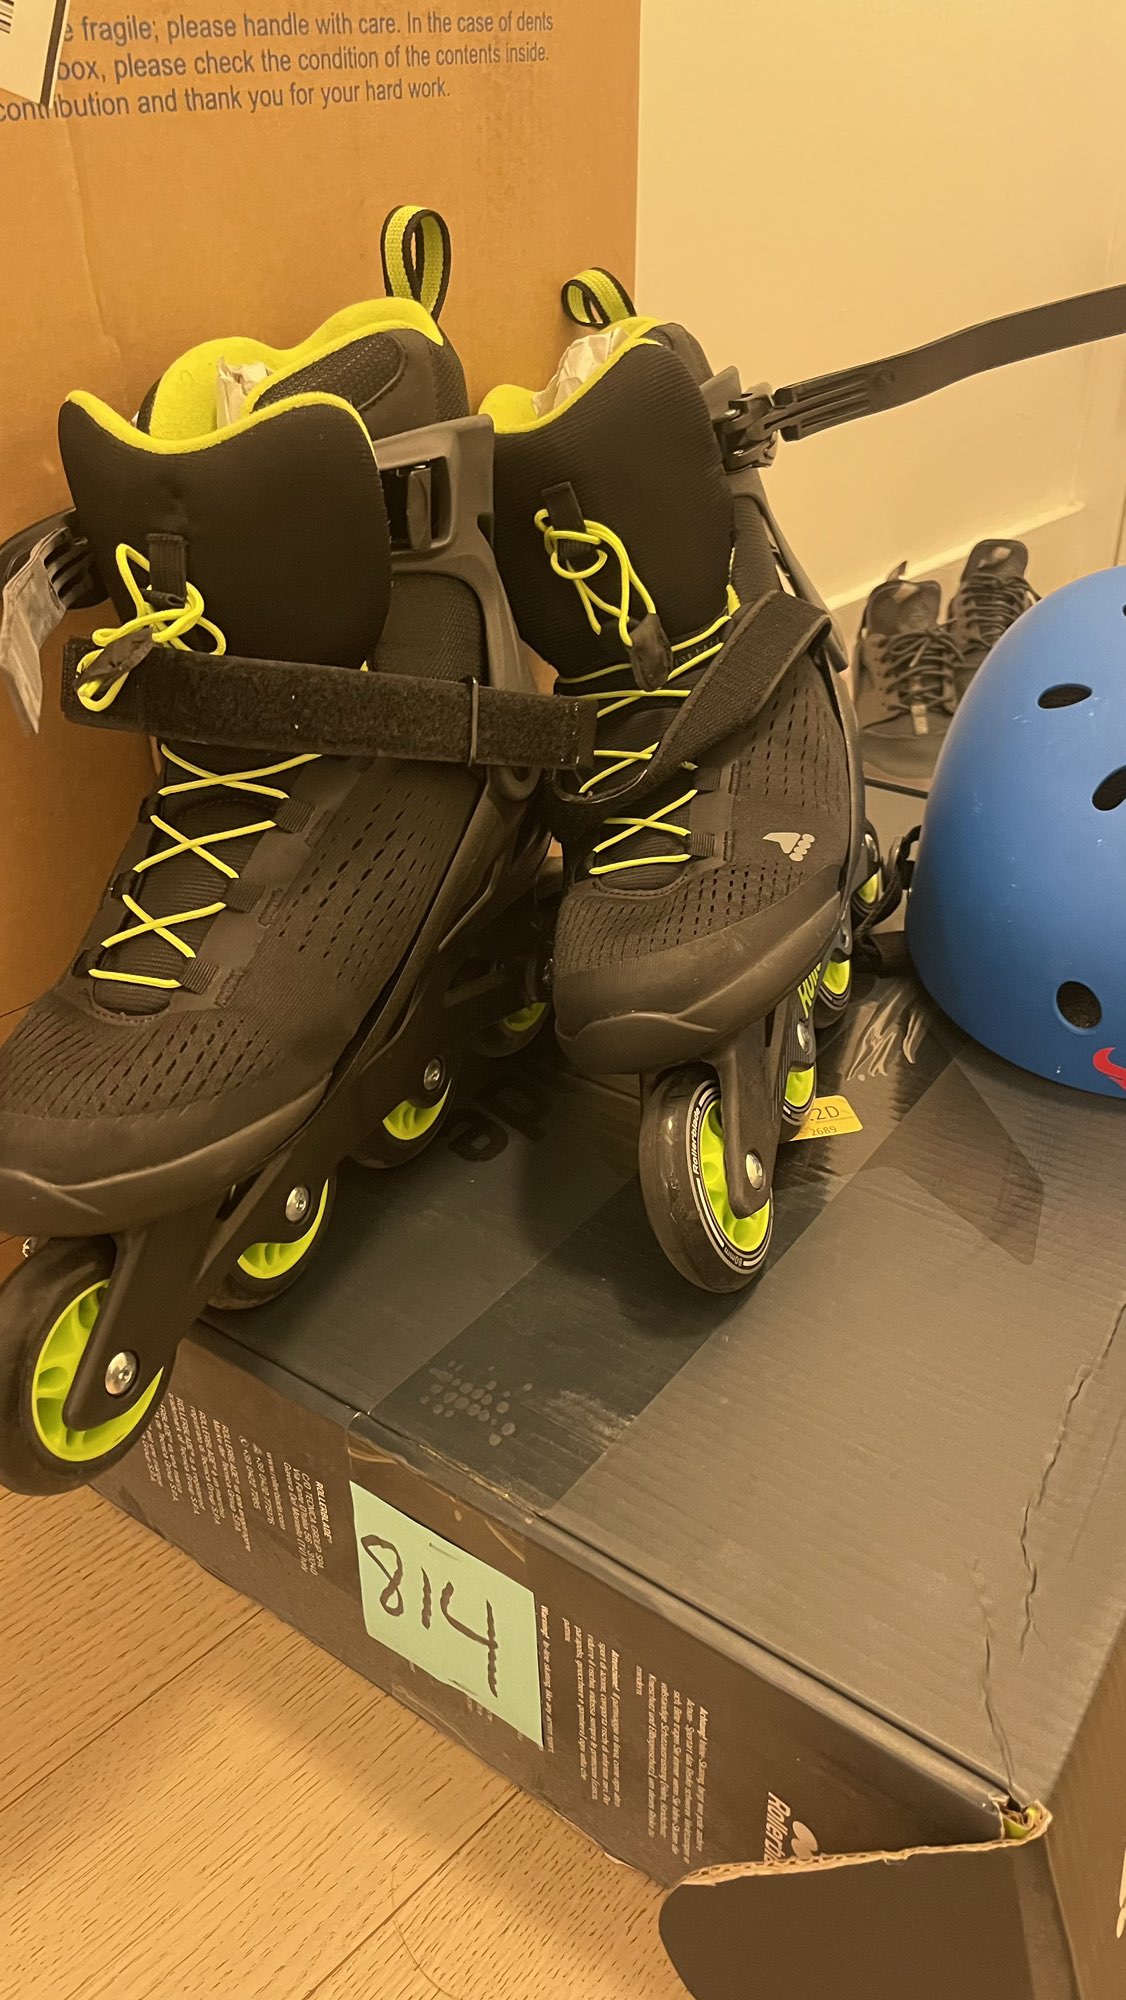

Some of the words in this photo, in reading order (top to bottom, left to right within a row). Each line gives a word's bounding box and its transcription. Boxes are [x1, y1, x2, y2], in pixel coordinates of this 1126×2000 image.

[82, 15, 158, 47] fragile;
[168, 14, 236, 45] please
[244, 12, 309, 37] handle
[316, 12, 352, 34] with
[359, 17, 400, 34] care.
[408, 12, 422, 33] In
[428, 11, 452, 32] the
[458, 15, 494, 32] case
[499, 10, 512, 32] of
[517, 11, 553, 32] dents
[115, 53, 186, 84] please
[194, 50, 254, 74] check
[262, 49, 291, 72] the
[298, 46, 378, 70] condition
[385, 45, 400, 68] of
[406, 45, 430, 66] the
[436, 44, 500, 65] contents
[506, 42, 549, 62] inside.
[138, 88, 177, 114] and
[185, 85, 242, 112] thank
[248, 88, 283, 113] you
[290, 82, 314, 106] for
[321, 85, 360, 110] your
[366, 78, 402, 100] hard
[408, 76, 450, 98] work.
[691, 1107, 700, 1174] Rollerblade
[306, 1492, 317, 1523] TECNICA
[311, 1525, 322, 1552] GROUP
[361, 1534, 498, 1698] 814
[540, 1605, 550, 1639] Warning!
